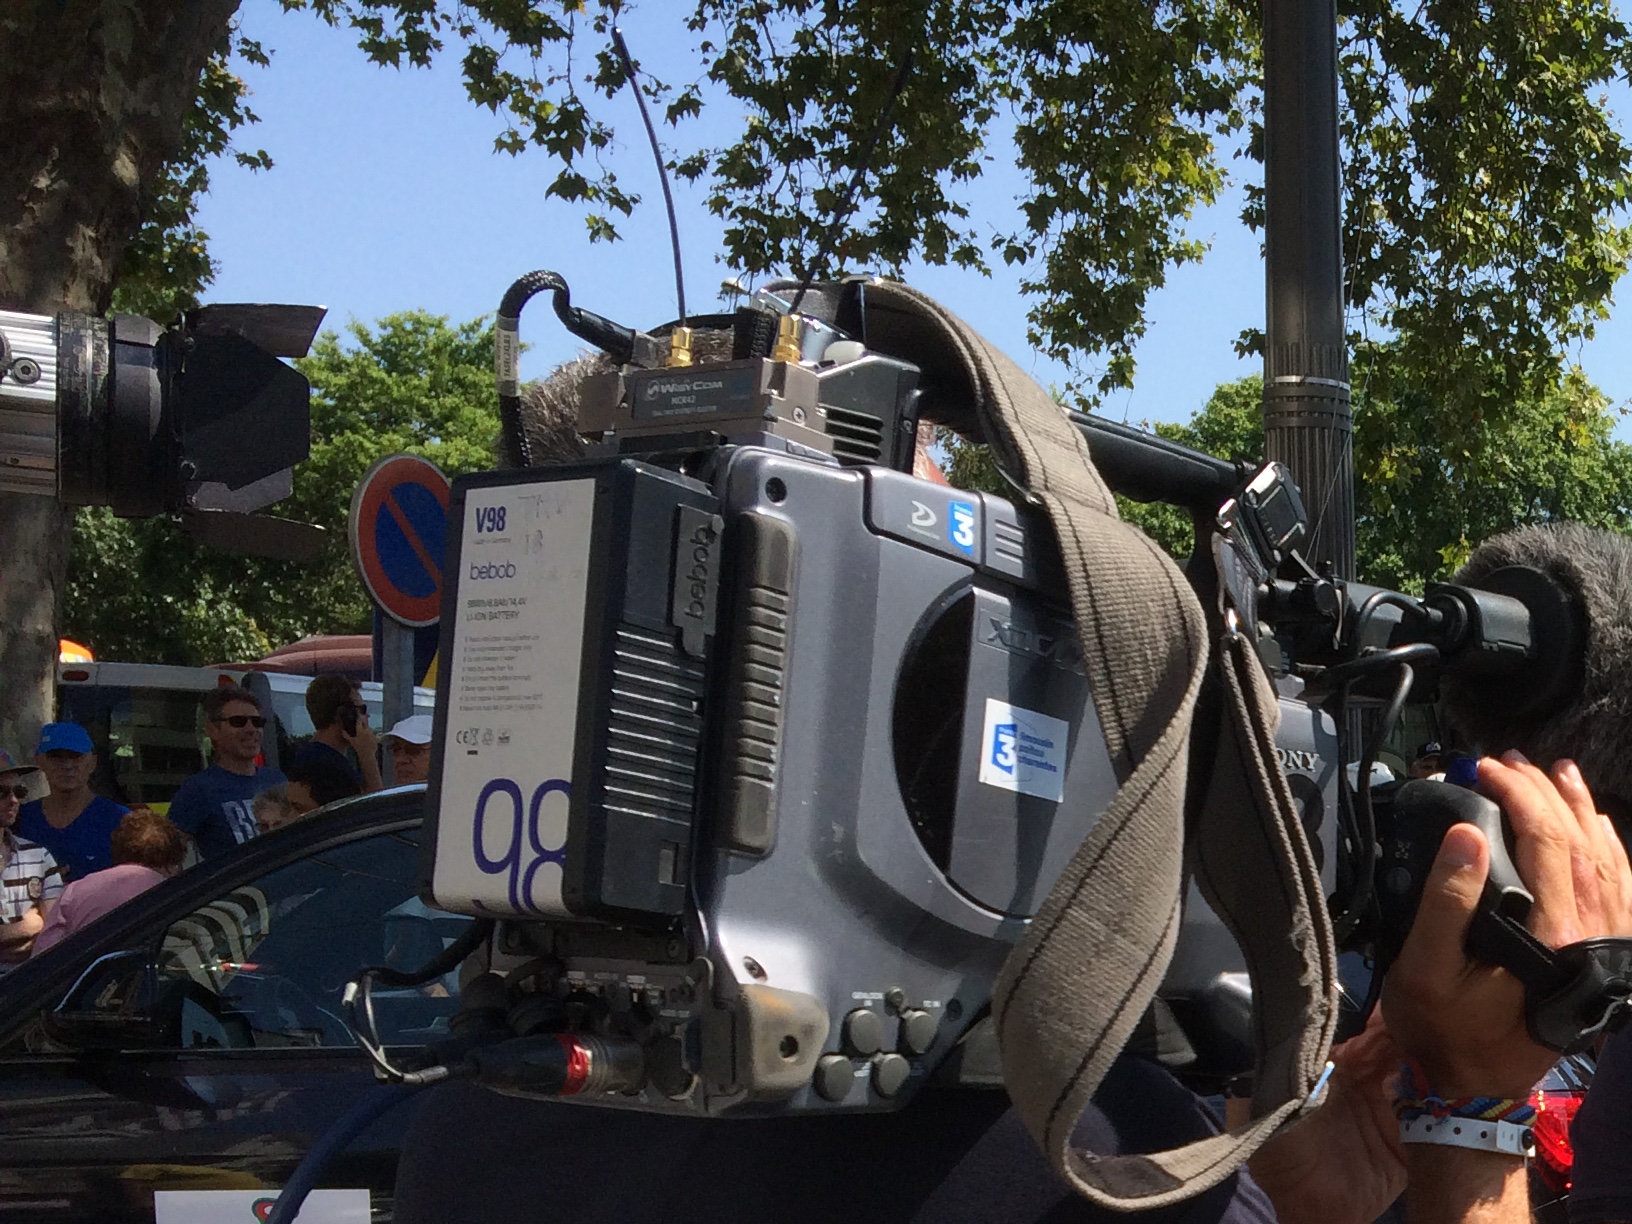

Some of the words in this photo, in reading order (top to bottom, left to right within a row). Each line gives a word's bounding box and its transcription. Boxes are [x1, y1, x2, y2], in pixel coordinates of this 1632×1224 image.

[476, 506, 507, 533] V98
[470, 559, 516, 580] bebob
[684, 525, 711, 620] bebob
